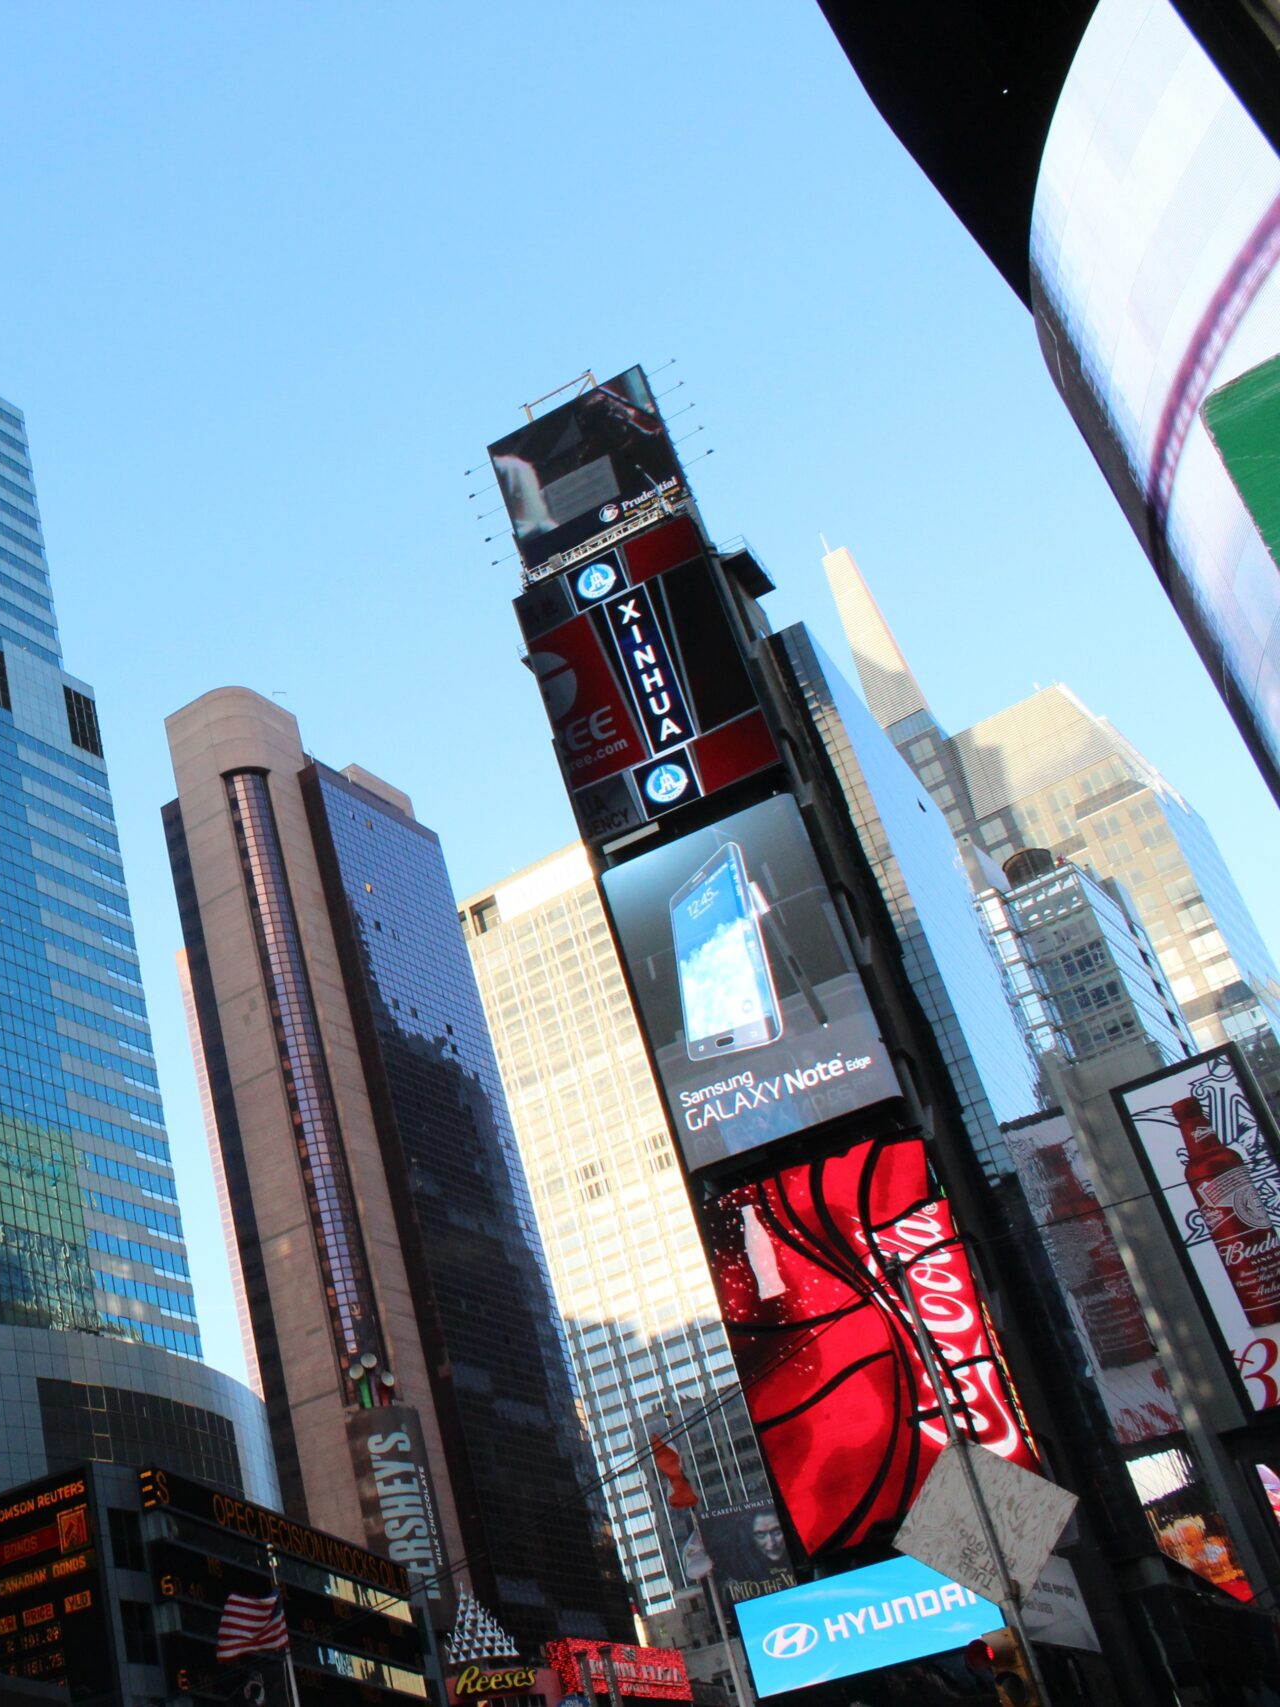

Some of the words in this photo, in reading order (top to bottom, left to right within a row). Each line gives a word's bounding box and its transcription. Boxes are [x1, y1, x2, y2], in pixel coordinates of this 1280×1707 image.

[617, 598, 682, 742] XINHUA
[556, 704, 618, 753] EE
[679, 1070, 754, 1108] Samsung
[684, 1076, 781, 1132] GALAXY
[784, 1057, 845, 1095] Note
[846, 1054, 872, 1072] Edge
[36, 1480, 85, 1508] REUTERS
[418, 1465, 437, 1536] CHOCOLATE
[711, 1505, 742, 1517] CAREFUL
[744, 1500, 765, 1510] WHAT
[3, 1535, 38, 1560] BONDS
[213, 1492, 258, 1538] OPEC
[259, 1510, 325, 1560] DECISION
[326, 1536, 379, 1584] KNOCKS
[432, 1538, 443, 1566] MILK
[52, 1555, 86, 1577] BONDS
[728, 1580, 761, 1601] INTO
[25, 1605, 52, 1624] PRICE
[824, 1582, 978, 1644] HYUNDAI
[455, 1665, 537, 1696] Reese's
